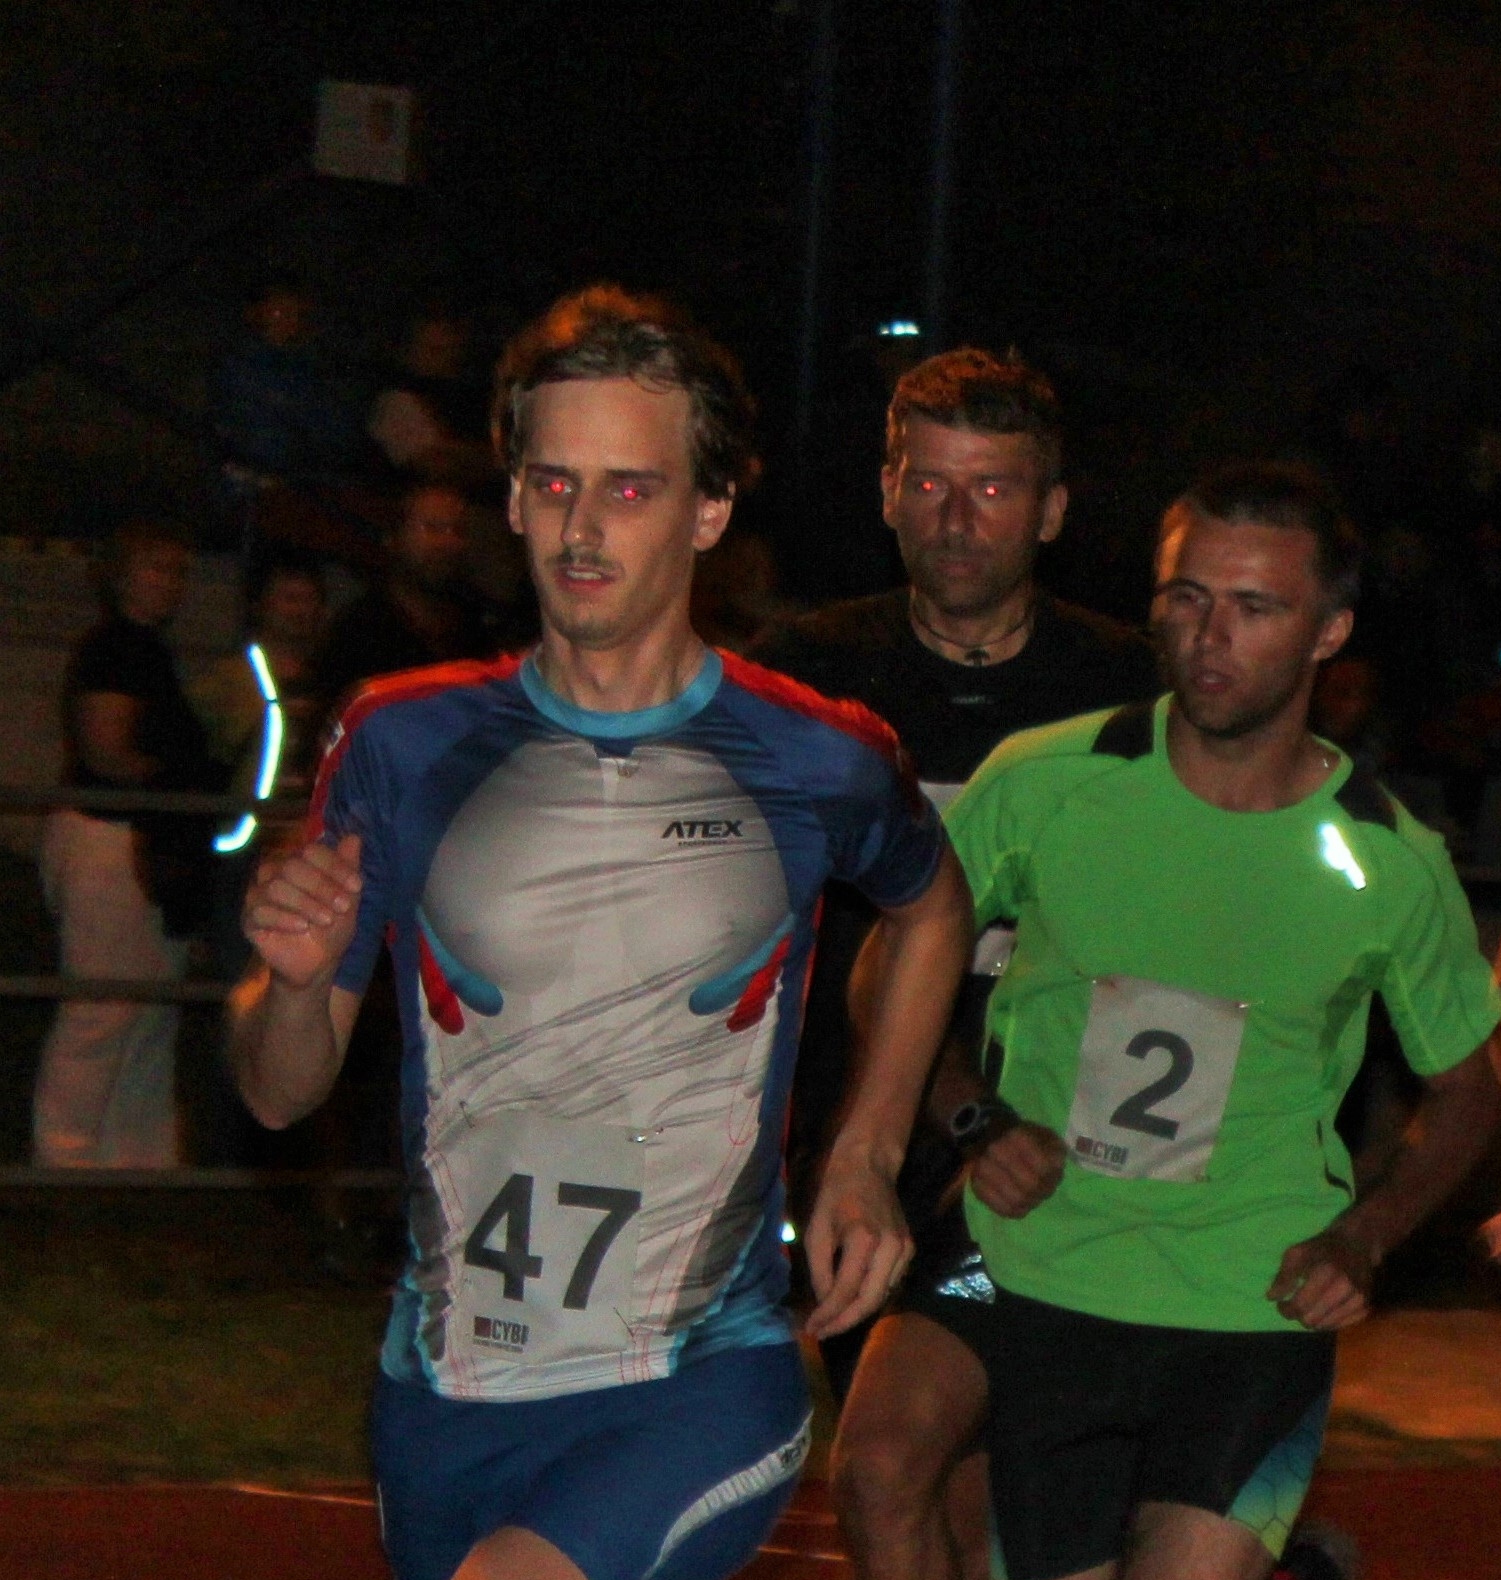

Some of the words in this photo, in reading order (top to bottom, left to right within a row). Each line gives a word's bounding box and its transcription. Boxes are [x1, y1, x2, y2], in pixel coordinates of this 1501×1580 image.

[662, 819, 743, 839] ATEX
[1110, 1030, 1194, 1140] 2
[464, 1173, 642, 1311] 47
